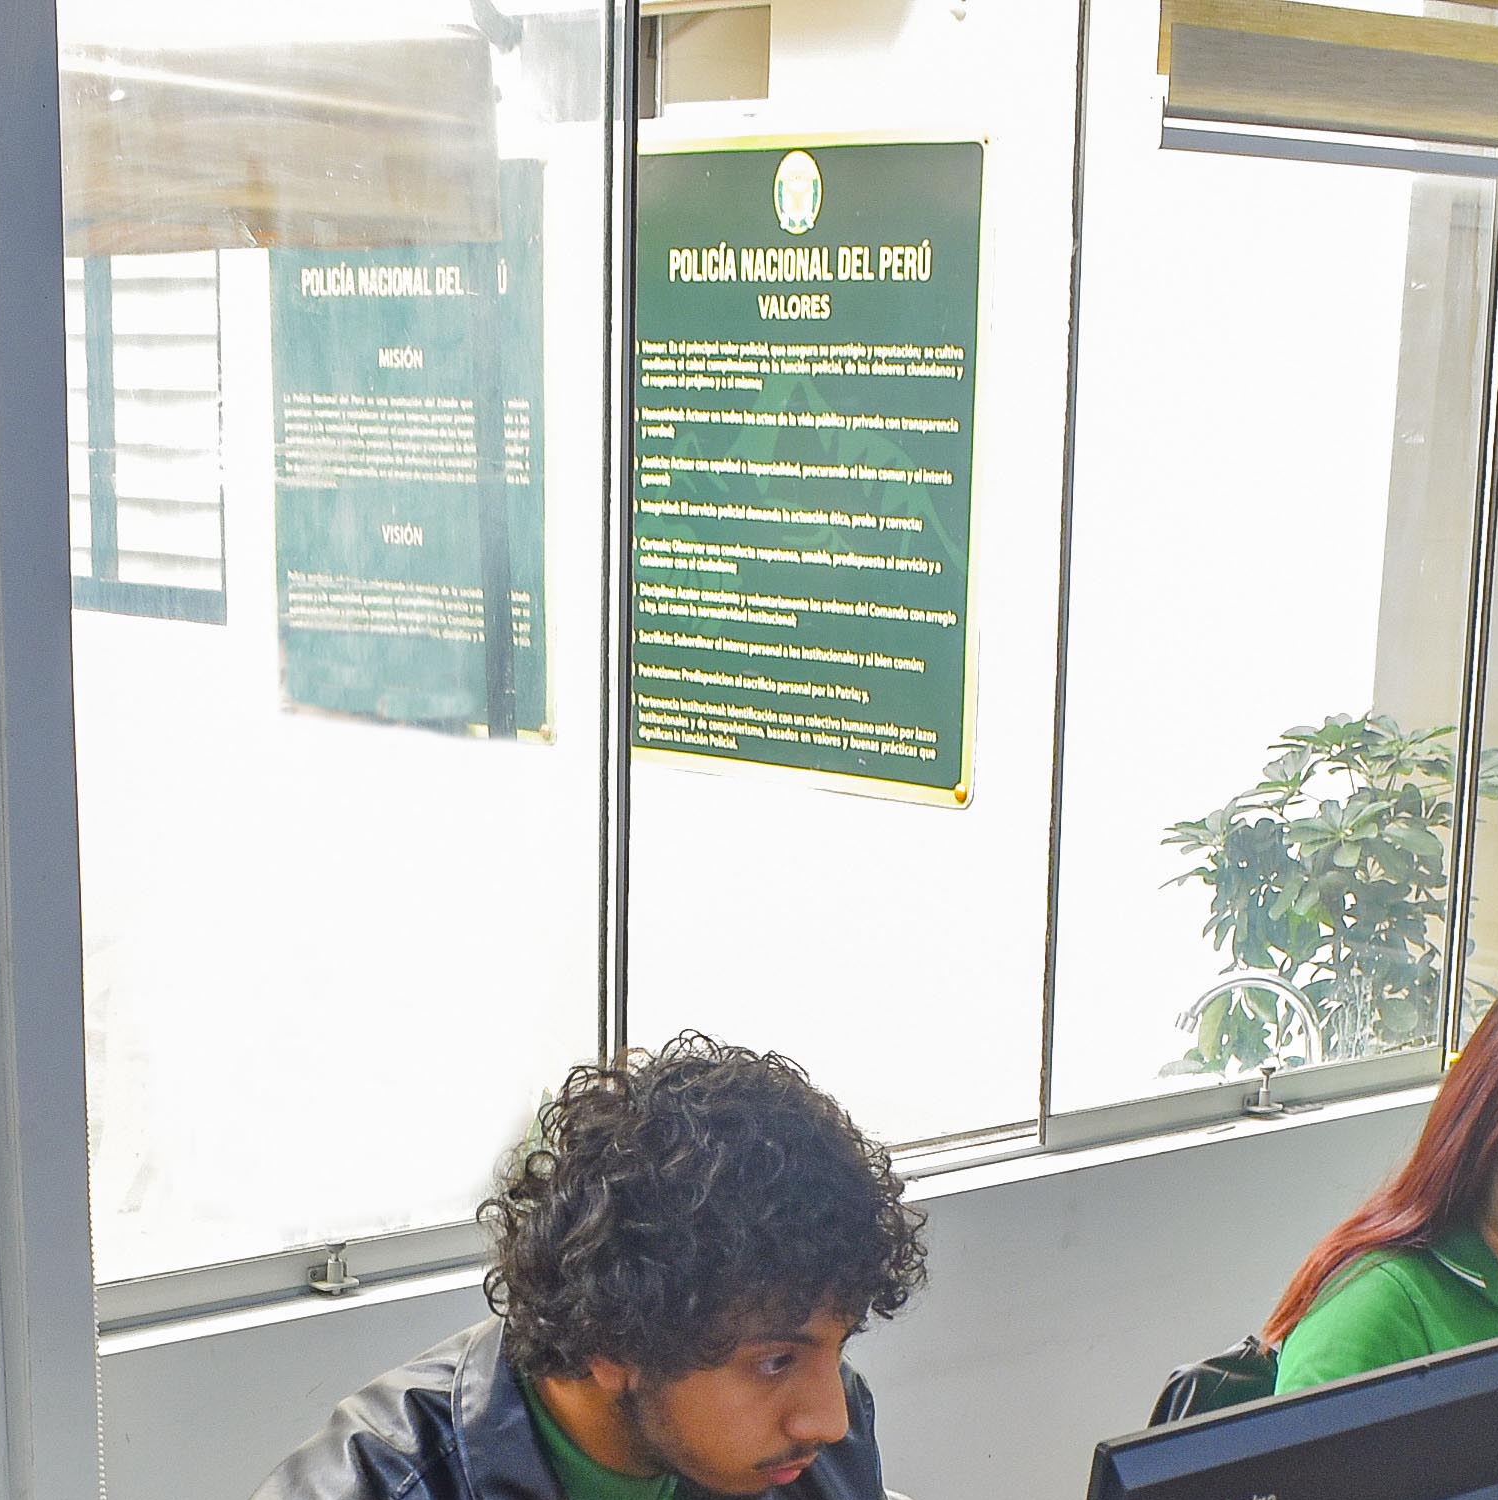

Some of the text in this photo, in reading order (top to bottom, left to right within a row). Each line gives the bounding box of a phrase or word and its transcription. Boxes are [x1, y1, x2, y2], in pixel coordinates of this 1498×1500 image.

[669, 238, 932, 282] POLICÍA NACIONAL DEL PERÚ
[301, 262, 356, 296] POLICÍA
[358, 265, 432, 297] NACIONAL
[435, 266, 464, 296] DEL
[758, 294, 831, 320] VALORES
[378, 346, 423, 368] MISIÓN
[381, 522, 423, 546] VISIÓN
